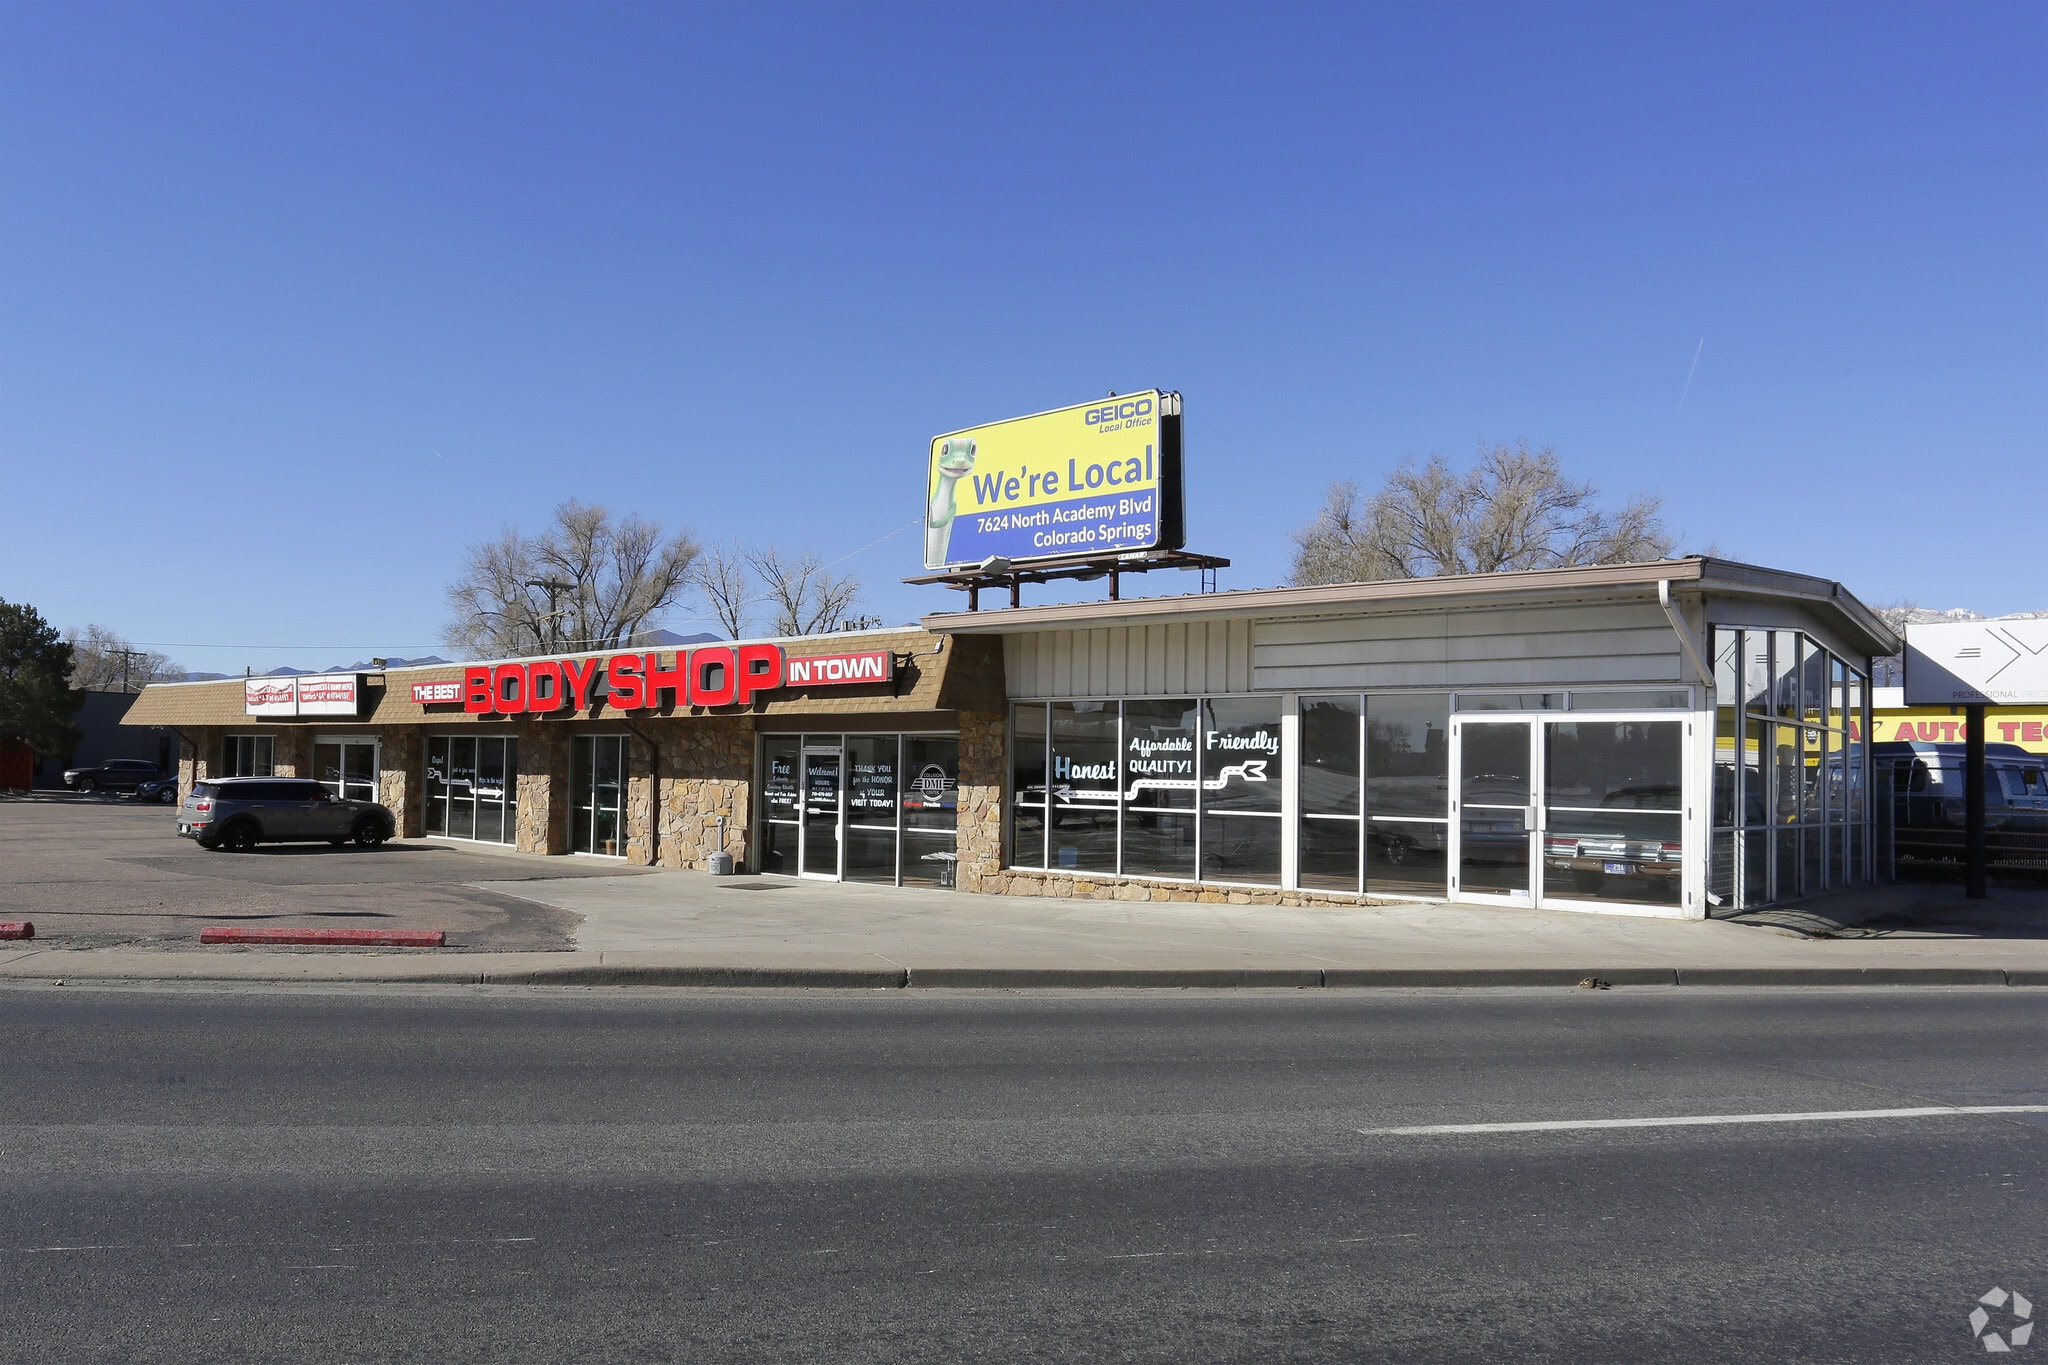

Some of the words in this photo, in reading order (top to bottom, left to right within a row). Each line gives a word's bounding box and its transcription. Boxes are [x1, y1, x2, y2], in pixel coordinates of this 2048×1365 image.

[1085, 399, 1152, 425] GEICO
[1099, 421, 1123, 433] Local
[1125, 418, 1152, 429] Office
[973, 465, 1058, 505] We're
[1069, 444, 1153, 492] Local
[977, 517, 1009, 533] 7624
[1011, 509, 1050, 529] North
[1052, 503, 1116, 524] Academy
[1119, 495, 1152, 516] Blvd
[1033, 526, 1096, 547] Colorado
[1098, 522, 1152, 543] Springs
[464, 657, 600, 714] BODY
[608, 643, 784, 710] SHOP
[790, 660, 811, 682] IN
[813, 656, 883, 680] TOWN
[413, 685, 433, 701] THE
[434, 683, 461, 700] BEST
[1952, 690, 2019, 699] PROFESSIONAL
[2021, 690, 2048, 698] PRECI
[1998, 721, 2048, 741] TE
[1129, 737, 1192, 757] Affordable
[1206, 731, 1279, 755] Friendly
[772, 760, 791, 775] Free
[855, 764, 875, 773] THANK
[877, 765, 892, 773] YOU
[1055, 756, 1116, 780] Honest
[1129, 759, 1192, 774] QUALITY!
[871, 775, 893, 784] HONOR
[924, 780, 943, 789] DMI
[867, 788, 885, 797] YOUR
[851, 798, 867, 807] VISIT
[869, 799, 894, 808] TODAY!
